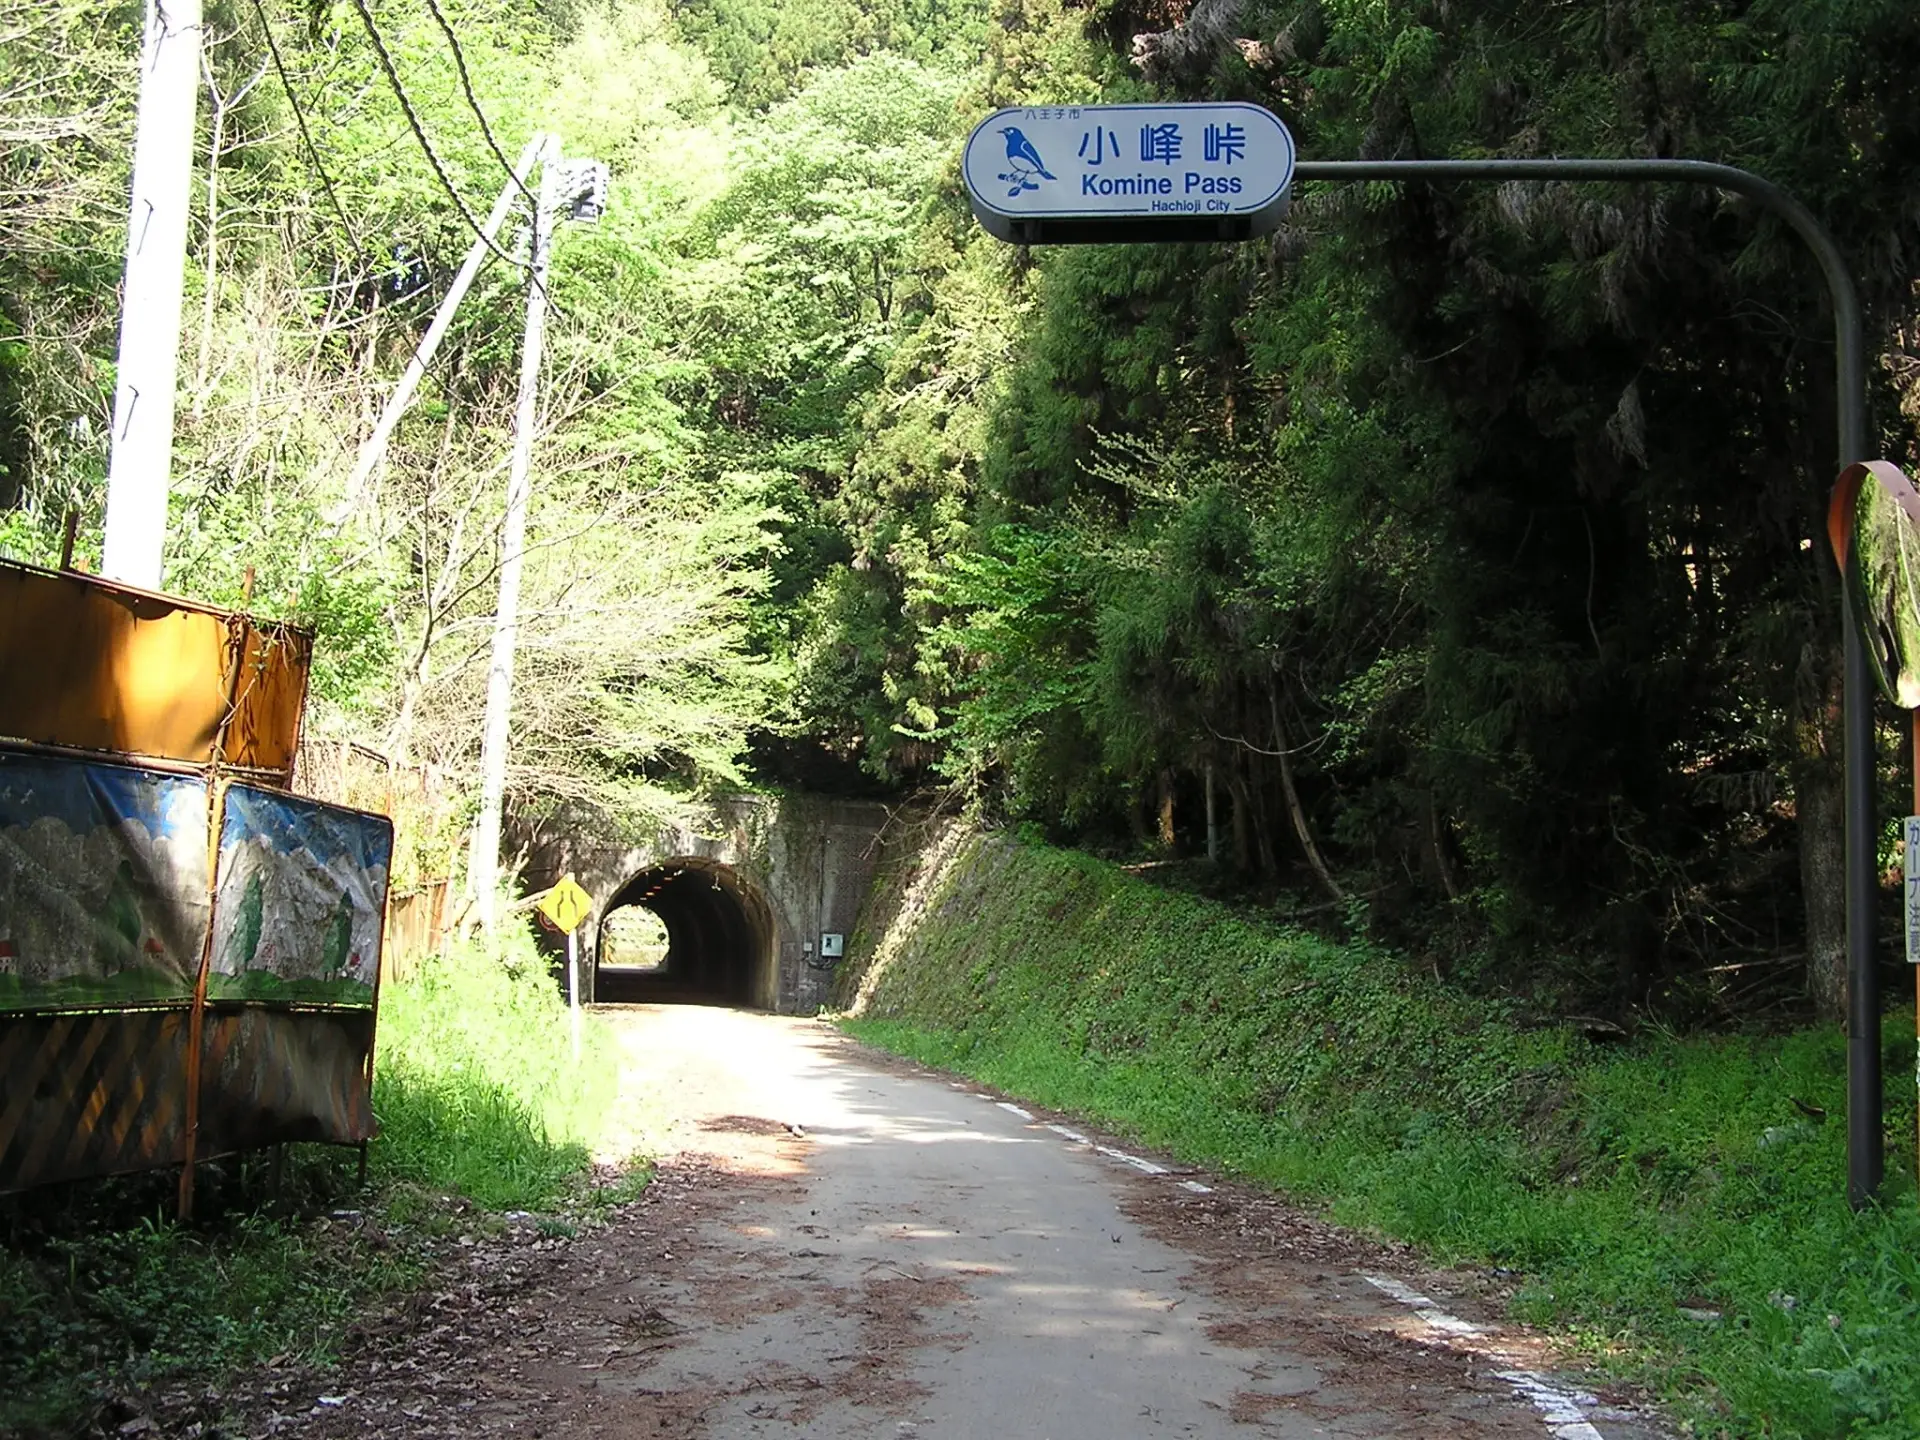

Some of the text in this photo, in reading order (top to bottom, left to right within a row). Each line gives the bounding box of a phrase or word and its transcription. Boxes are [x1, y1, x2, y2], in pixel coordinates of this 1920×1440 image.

[1025, 108, 1081, 120] 八王子市
[1078, 122, 1246, 166] 小峰峠
[1082, 172, 1242, 195] Komine Pass
[1152, 199, 1230, 213] Hachioji City
